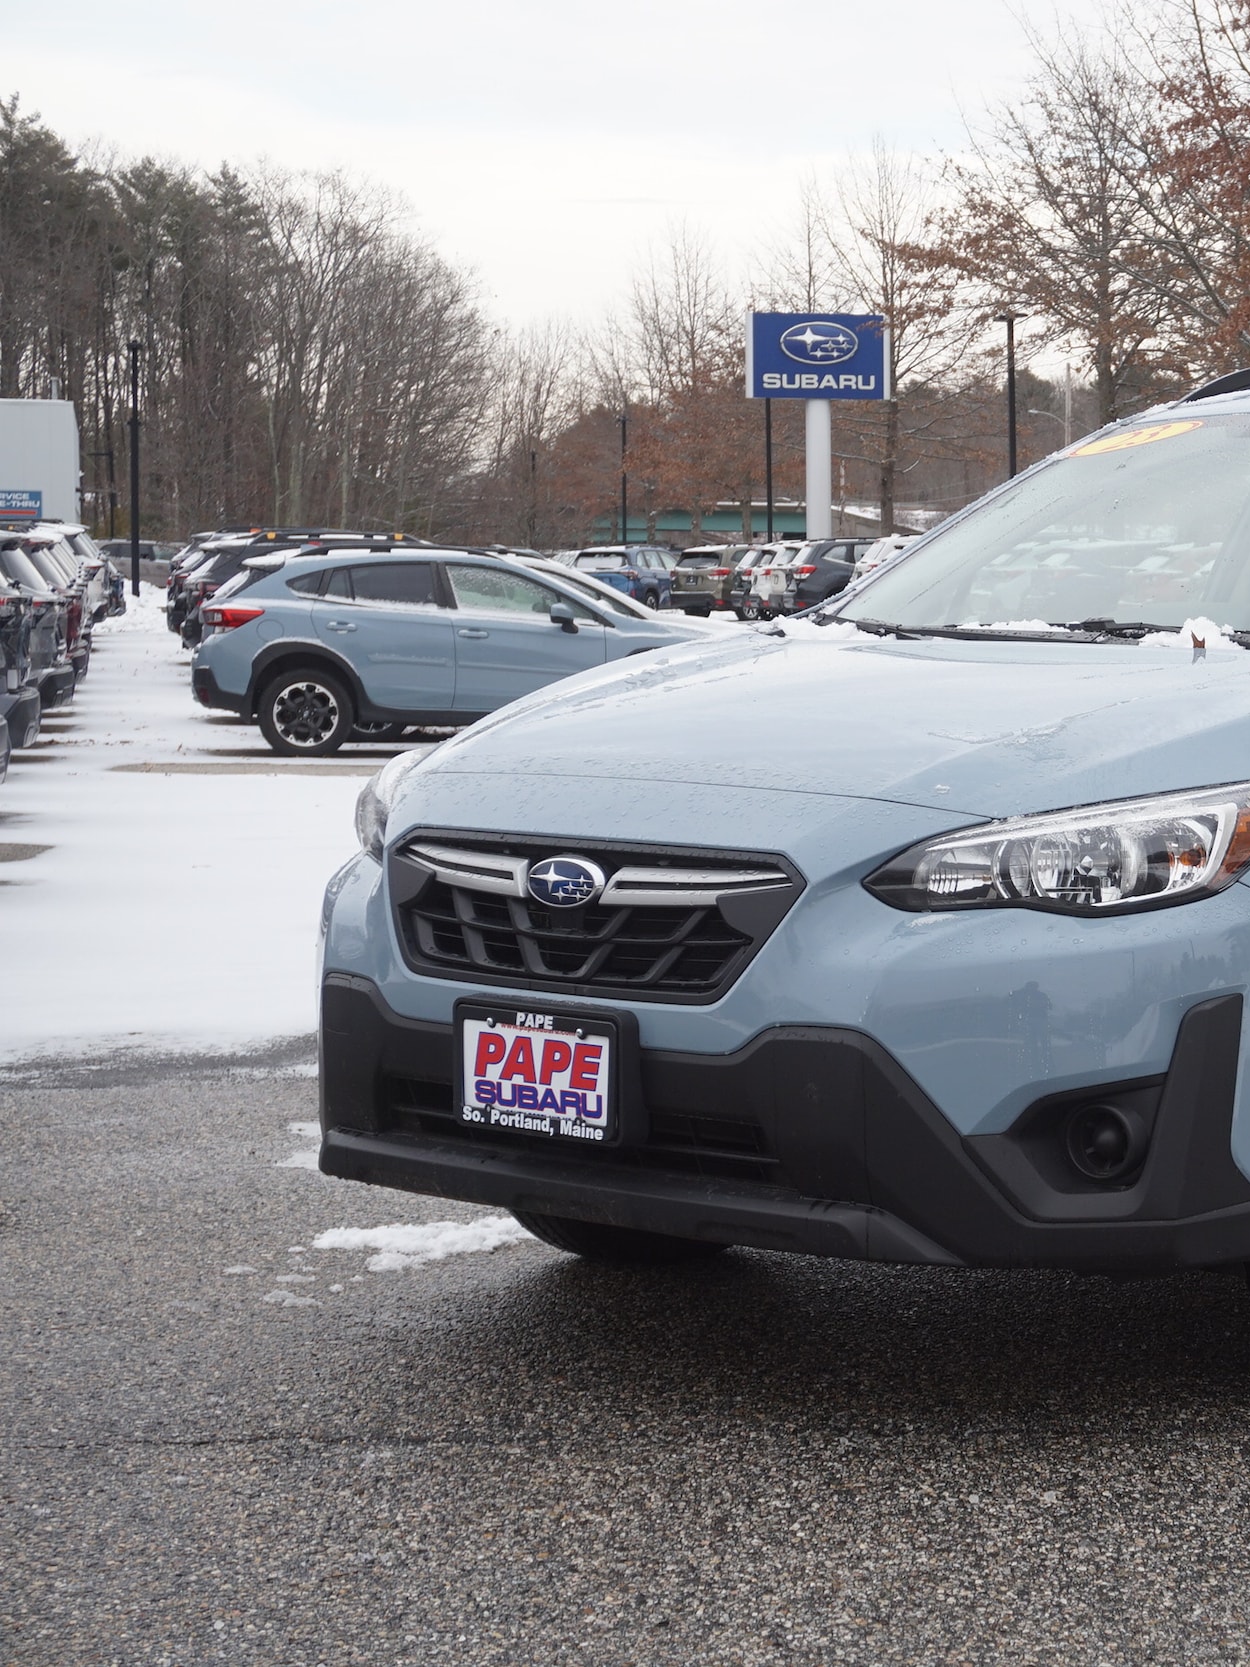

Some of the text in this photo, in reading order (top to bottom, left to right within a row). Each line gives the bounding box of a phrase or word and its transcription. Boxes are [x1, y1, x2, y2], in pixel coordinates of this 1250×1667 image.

[762, 372, 876, 391] SUBARU
[515, 1011, 554, 1030] PAPE
[473, 1031, 603, 1092] PAPE
[474, 1079, 603, 1120] SUBARU
[462, 1105, 485, 1123] So.
[490, 1108, 554, 1136] Portland,
[559, 1119, 604, 1141] Maine
